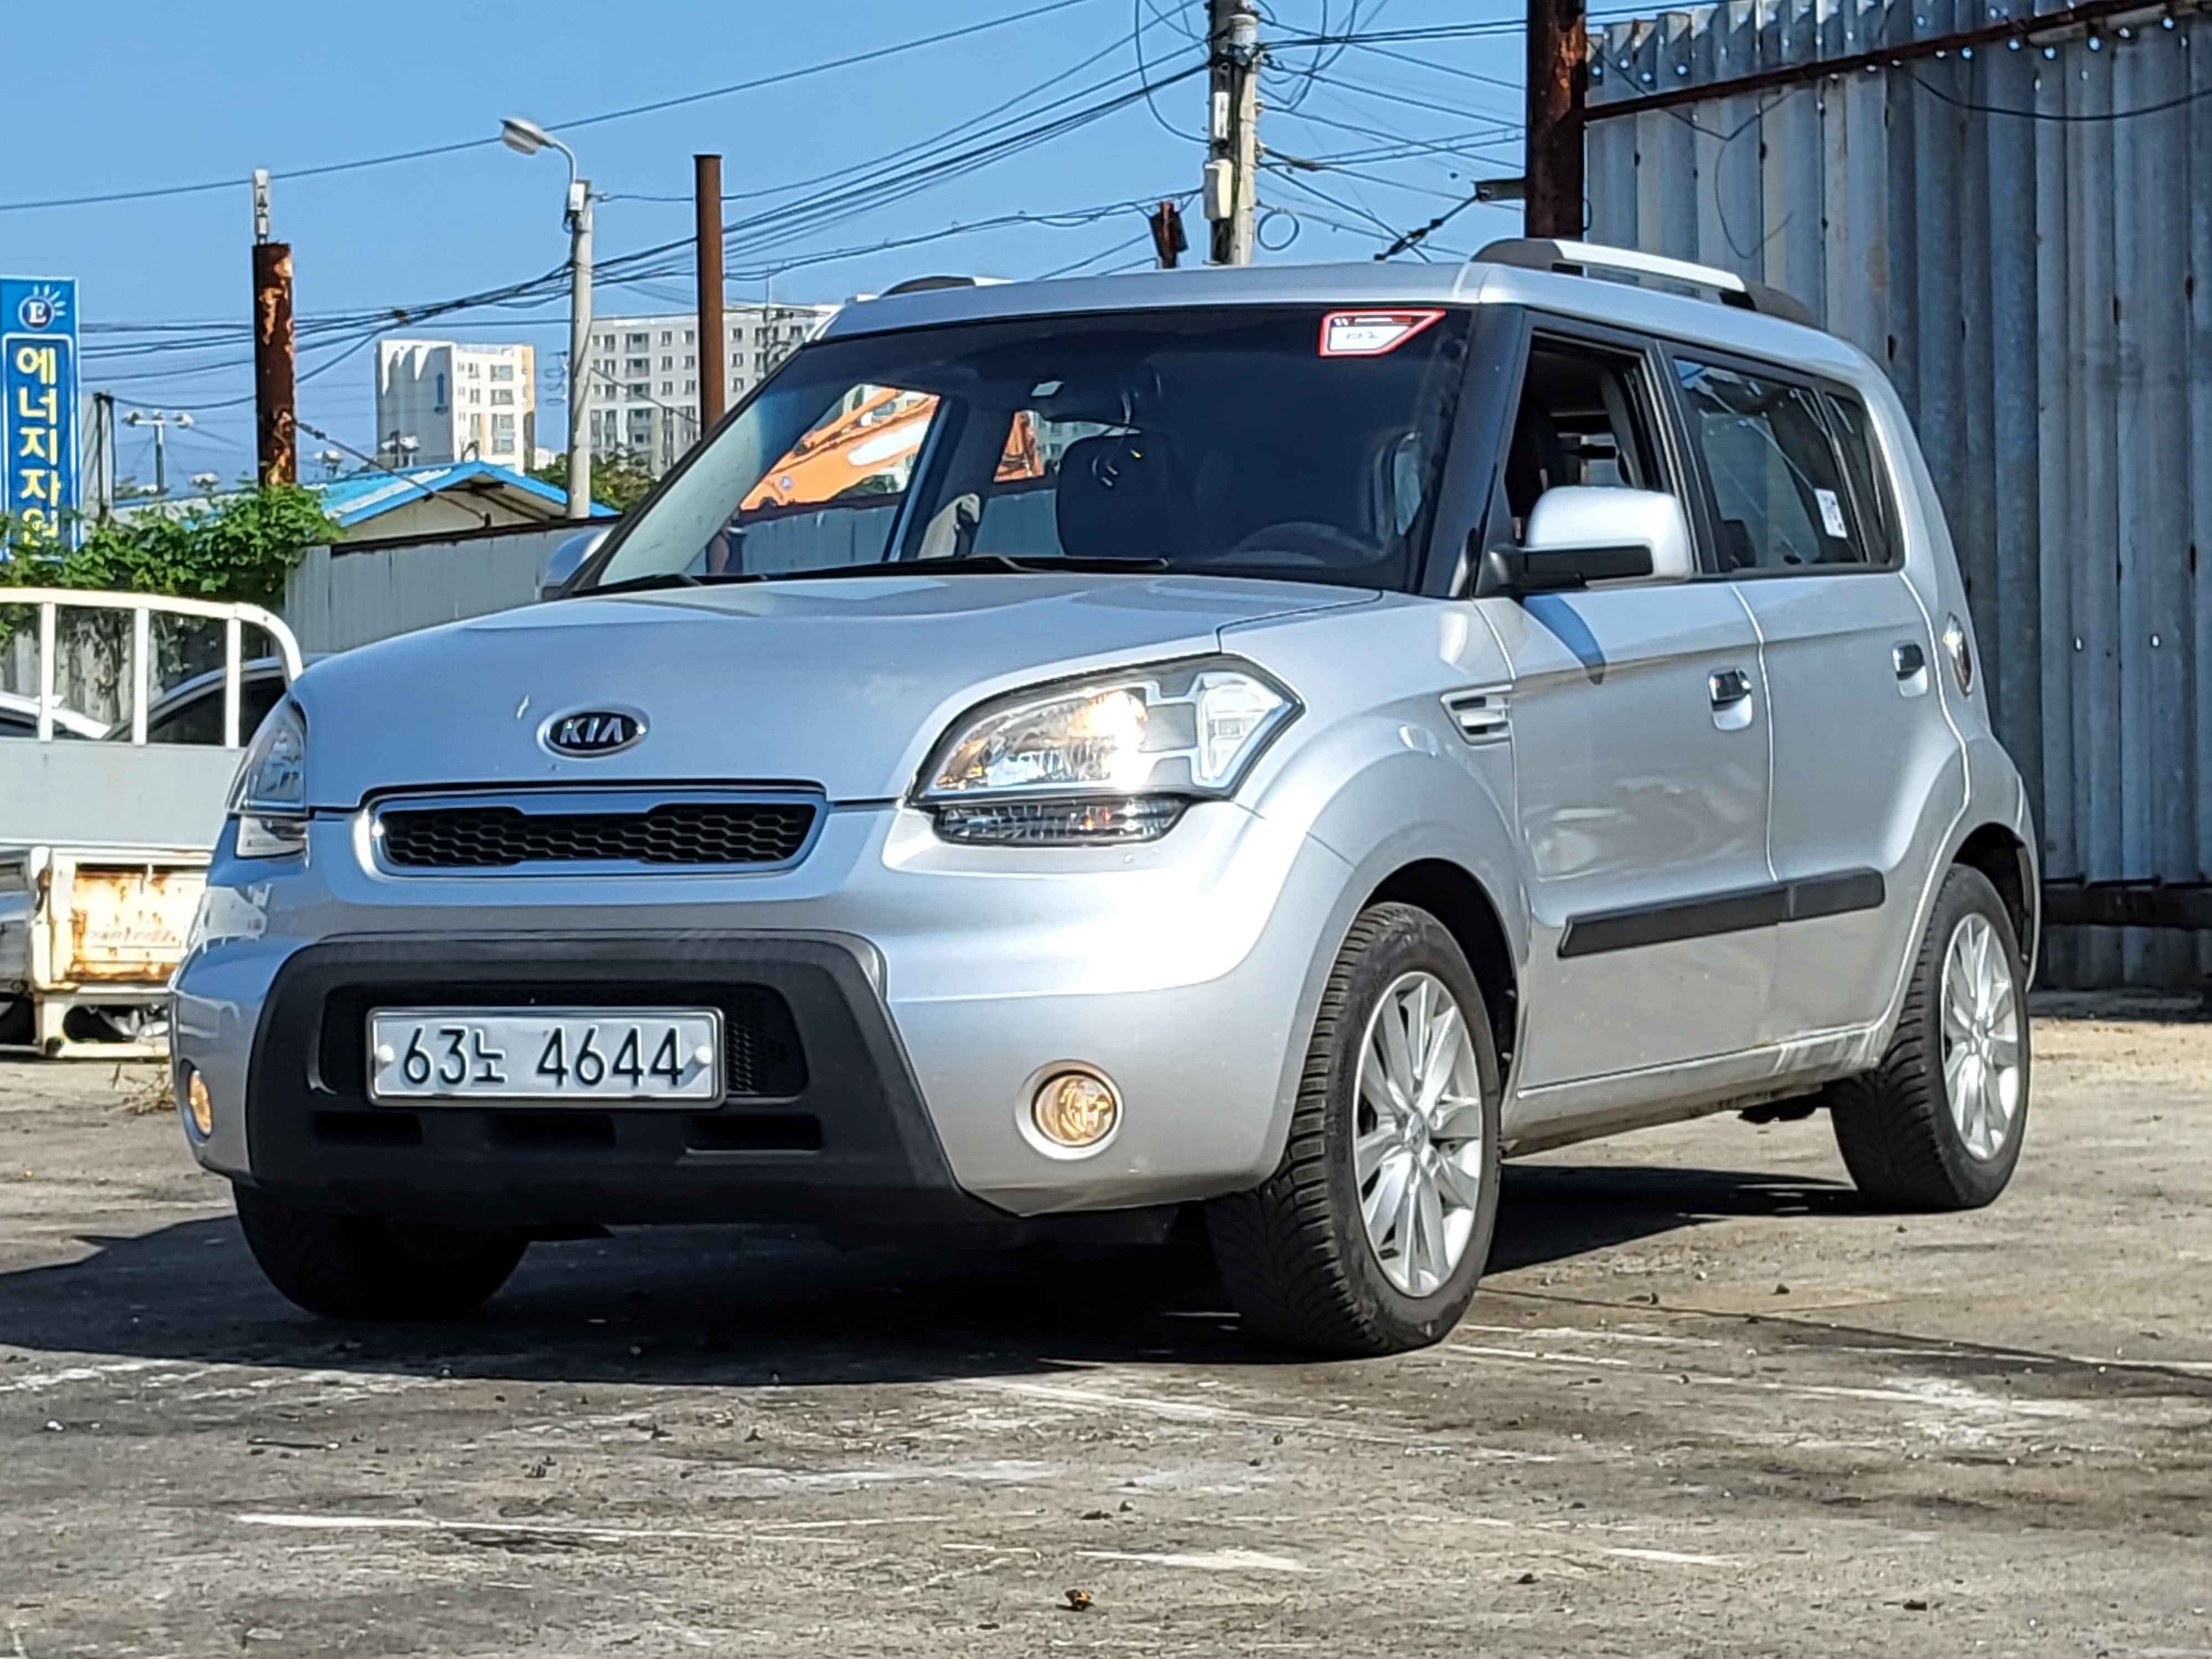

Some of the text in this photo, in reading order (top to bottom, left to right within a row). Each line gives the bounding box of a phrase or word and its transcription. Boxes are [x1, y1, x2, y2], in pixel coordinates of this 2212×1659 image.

[28, 302, 46, 323] E
[559, 718, 624, 743] KIA
[403, 1027, 684, 1087] 63노 4644
